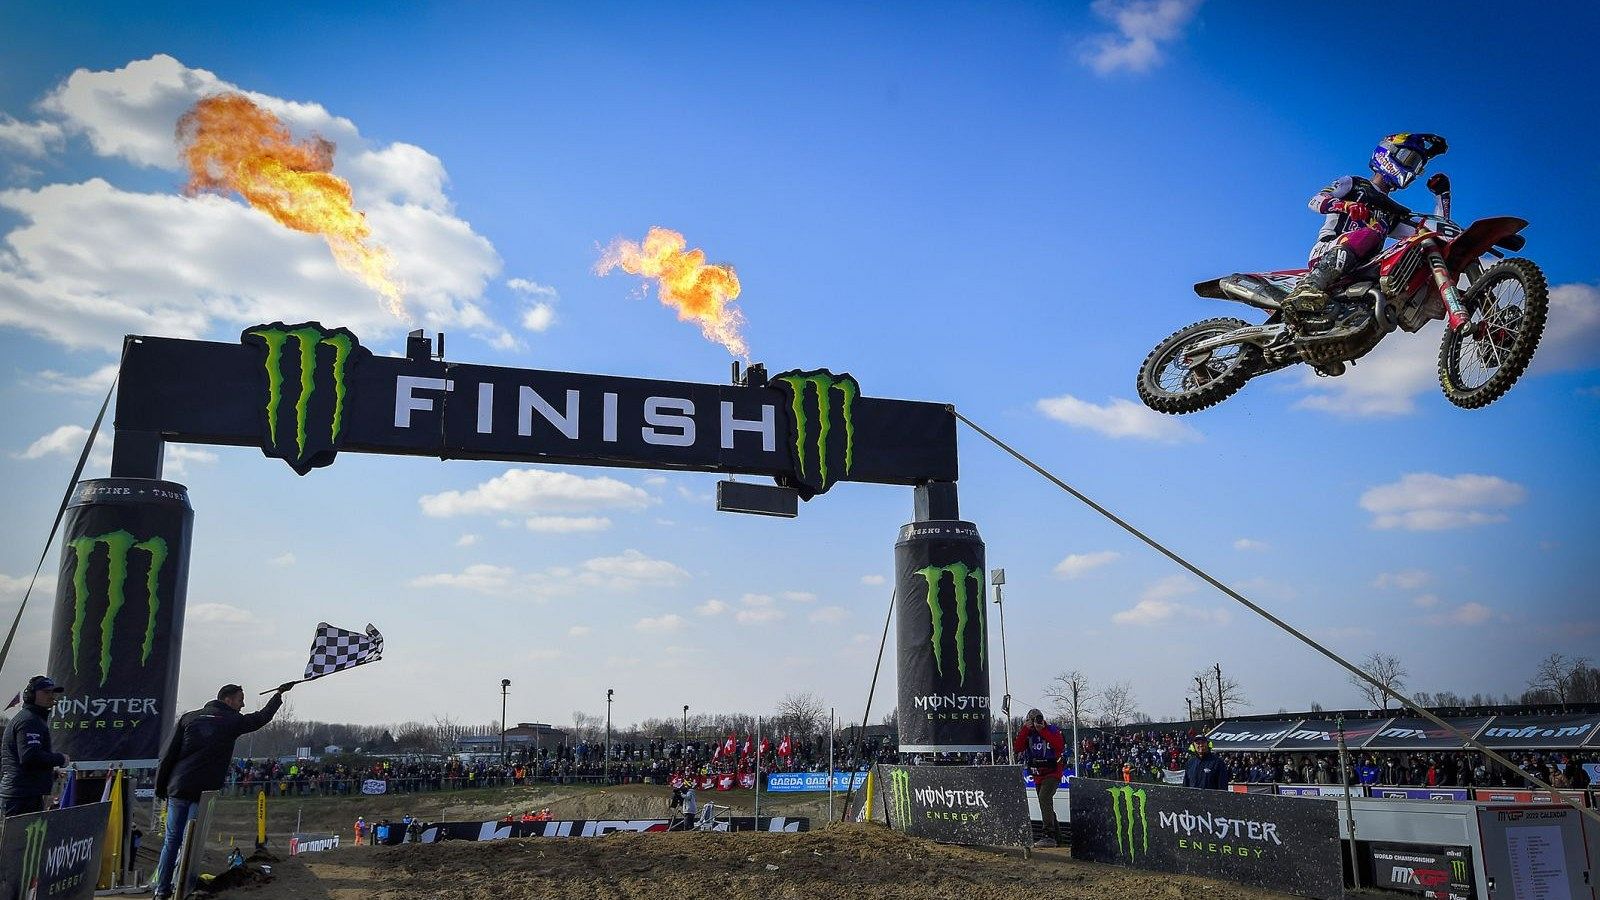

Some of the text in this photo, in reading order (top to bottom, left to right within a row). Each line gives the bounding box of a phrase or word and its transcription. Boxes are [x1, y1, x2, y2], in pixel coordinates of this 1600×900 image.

[394, 375, 776, 452] FINISH
[53, 719, 141, 729] ENERGY
[770, 777, 803, 786] GARDA
[805, 777, 838, 786] GARA
[926, 811, 980, 821] ENERGY
[1158, 809, 1282, 846] MONSTER
[1179, 839, 1263, 858] ENERGY
[1393, 855, 1436, 863] CHAMPIONSHIP
